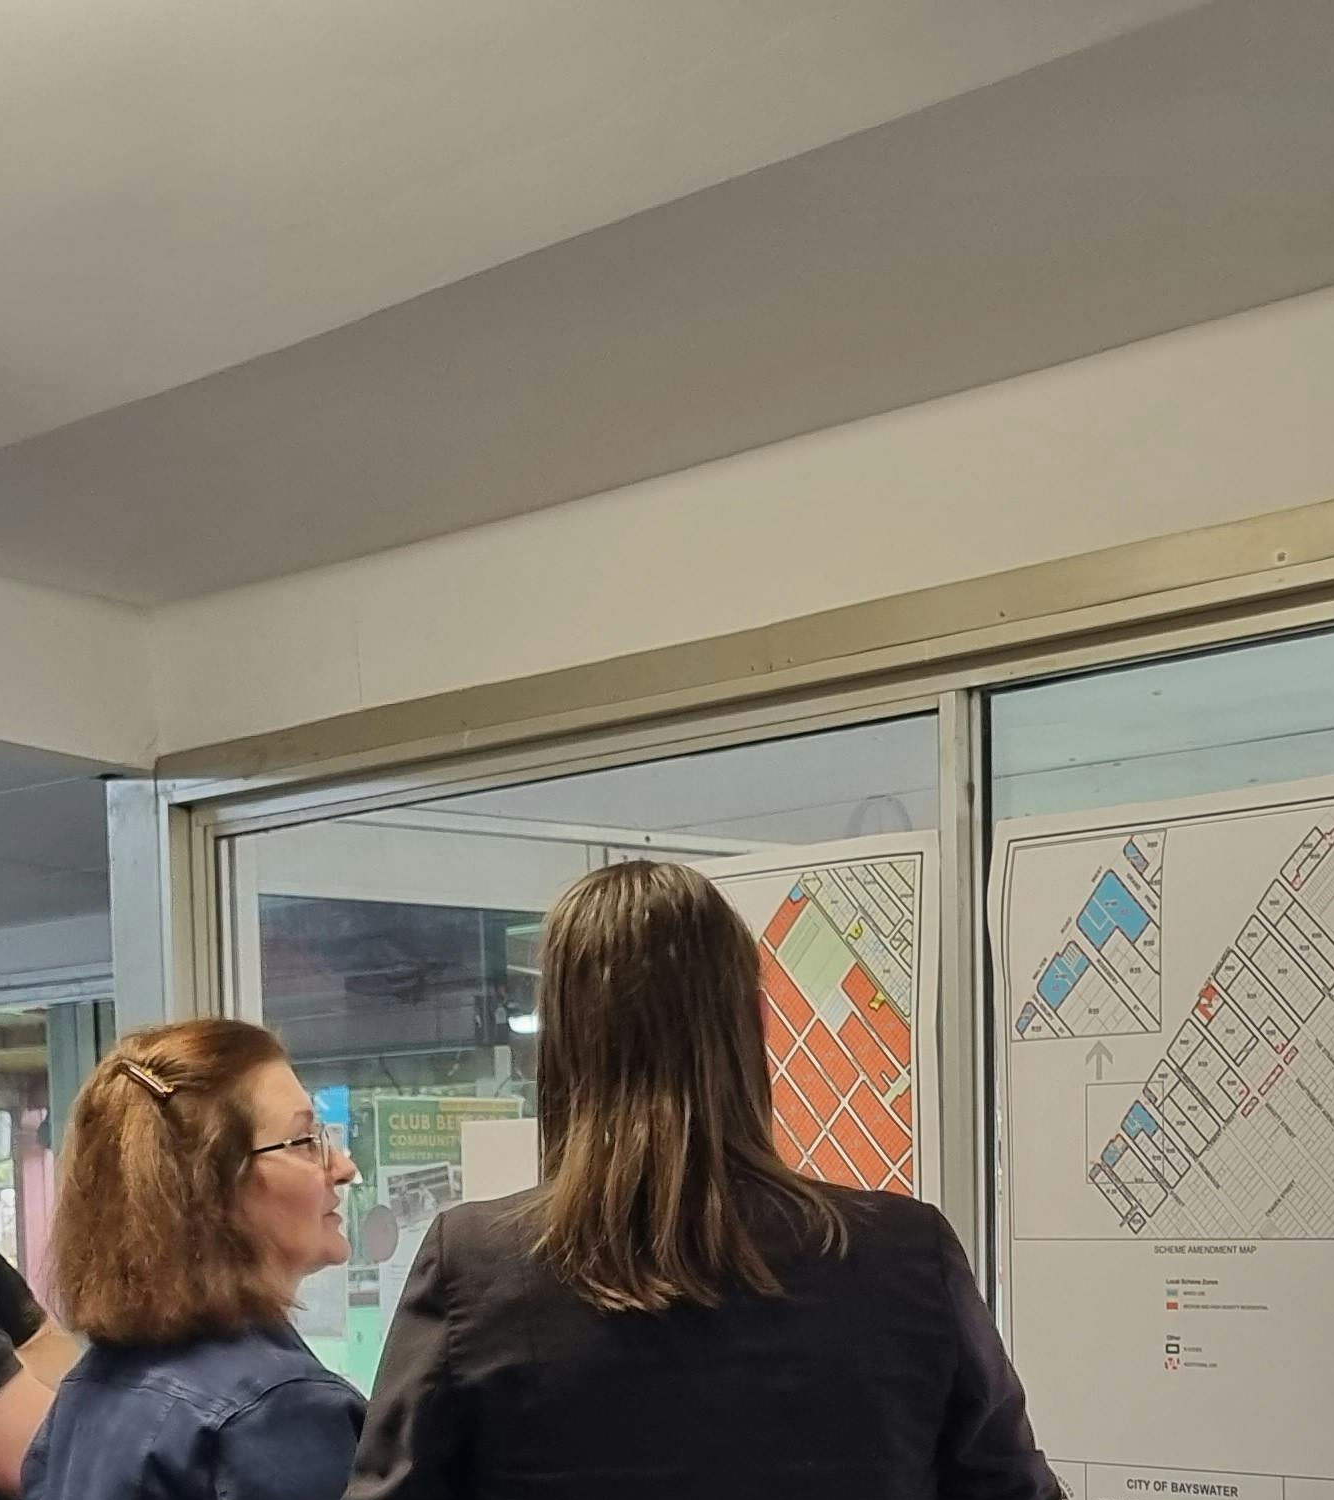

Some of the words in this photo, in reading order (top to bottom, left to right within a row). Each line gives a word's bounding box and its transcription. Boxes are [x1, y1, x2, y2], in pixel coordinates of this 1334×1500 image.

[388, 1114, 431, 1130] CLUB
[389, 1134, 461, 1147] COMMUNIT
[1154, 1245, 1186, 1254] SCHEME
[1188, 1245, 1237, 1254] AMENDMENT
[1239, 1245, 1257, 1255] MAP
[1127, 1478, 1150, 1491] CITY
[1154, 1481, 1167, 1491] OF
[1171, 1482, 1238, 1497] BAYSWATER
